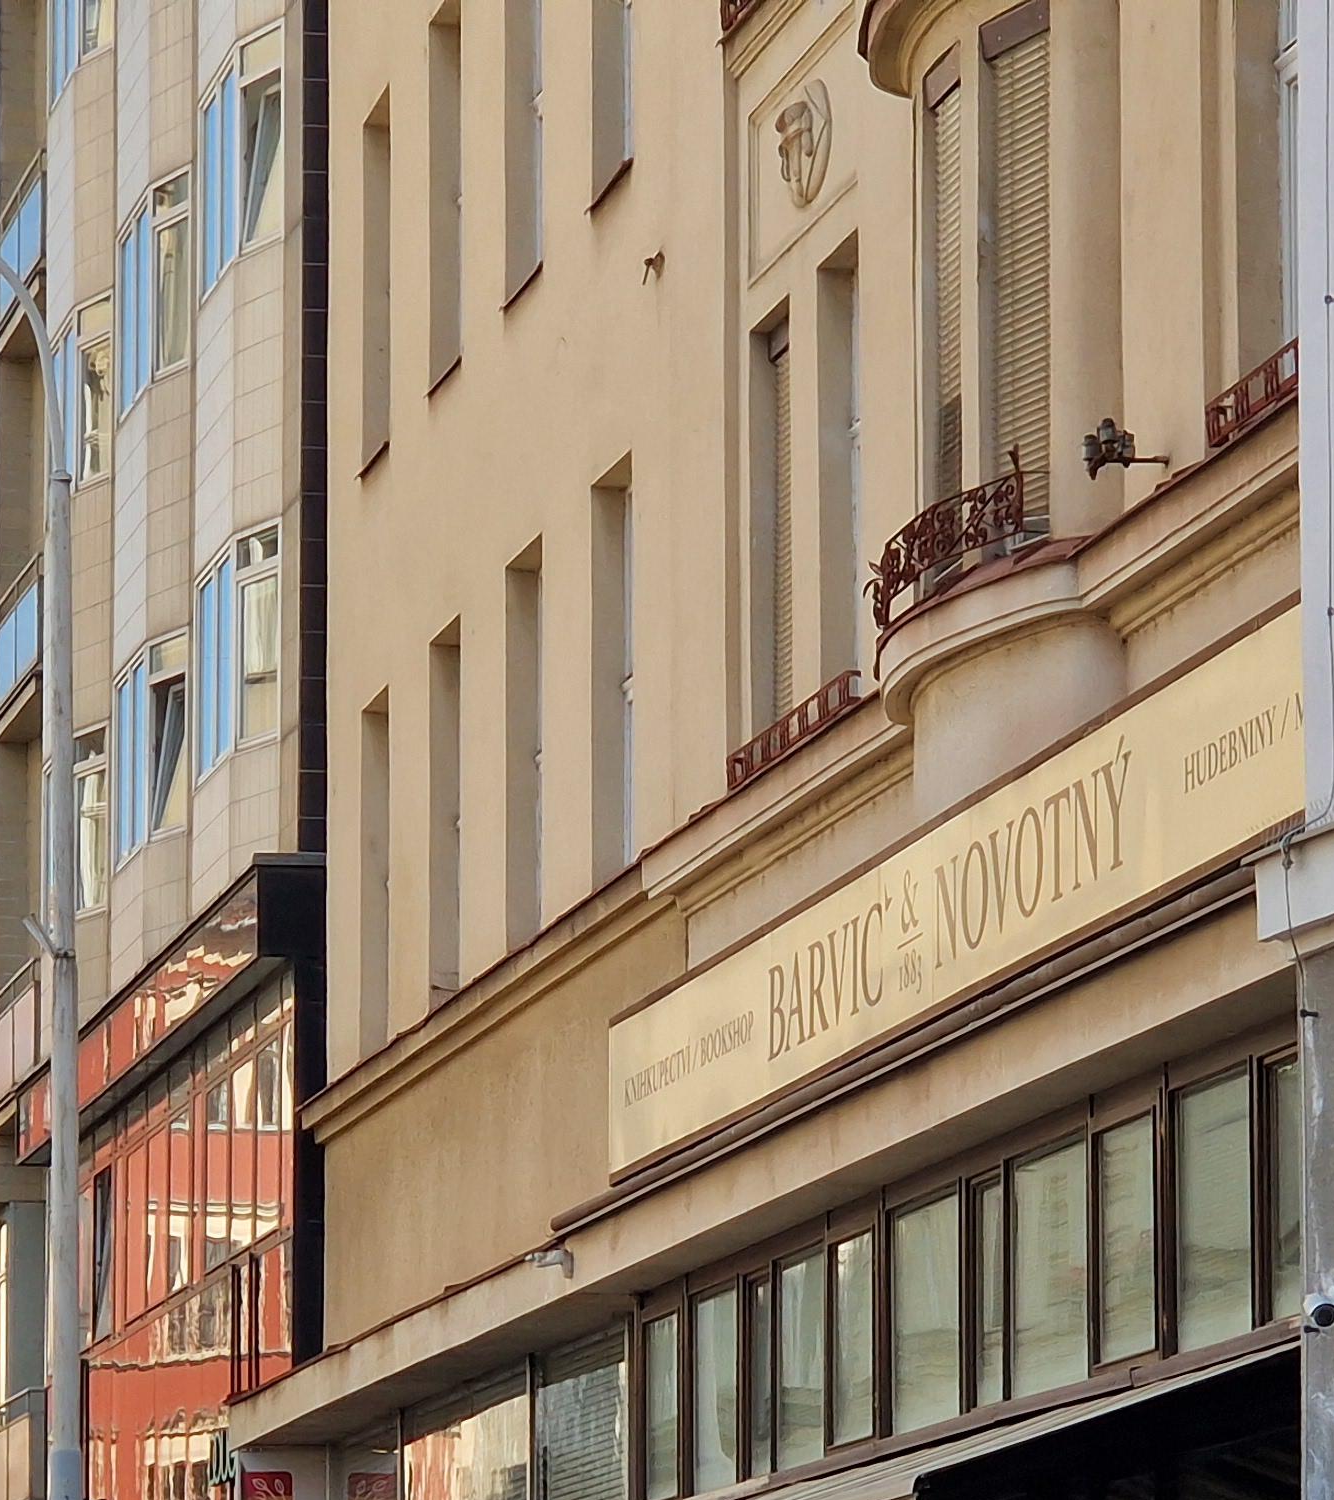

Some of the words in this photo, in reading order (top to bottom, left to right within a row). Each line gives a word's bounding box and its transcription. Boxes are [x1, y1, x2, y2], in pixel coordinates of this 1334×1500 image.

[1183, 704, 1277, 794] HUDEBNINY
[934, 734, 1132, 970] NOVOTNÝ
[898, 949, 923, 995] 1883
[623, 1035, 691, 1109] KNIHKUPECTVÍ
[700, 1010, 755, 1068] BOOKSHOP
